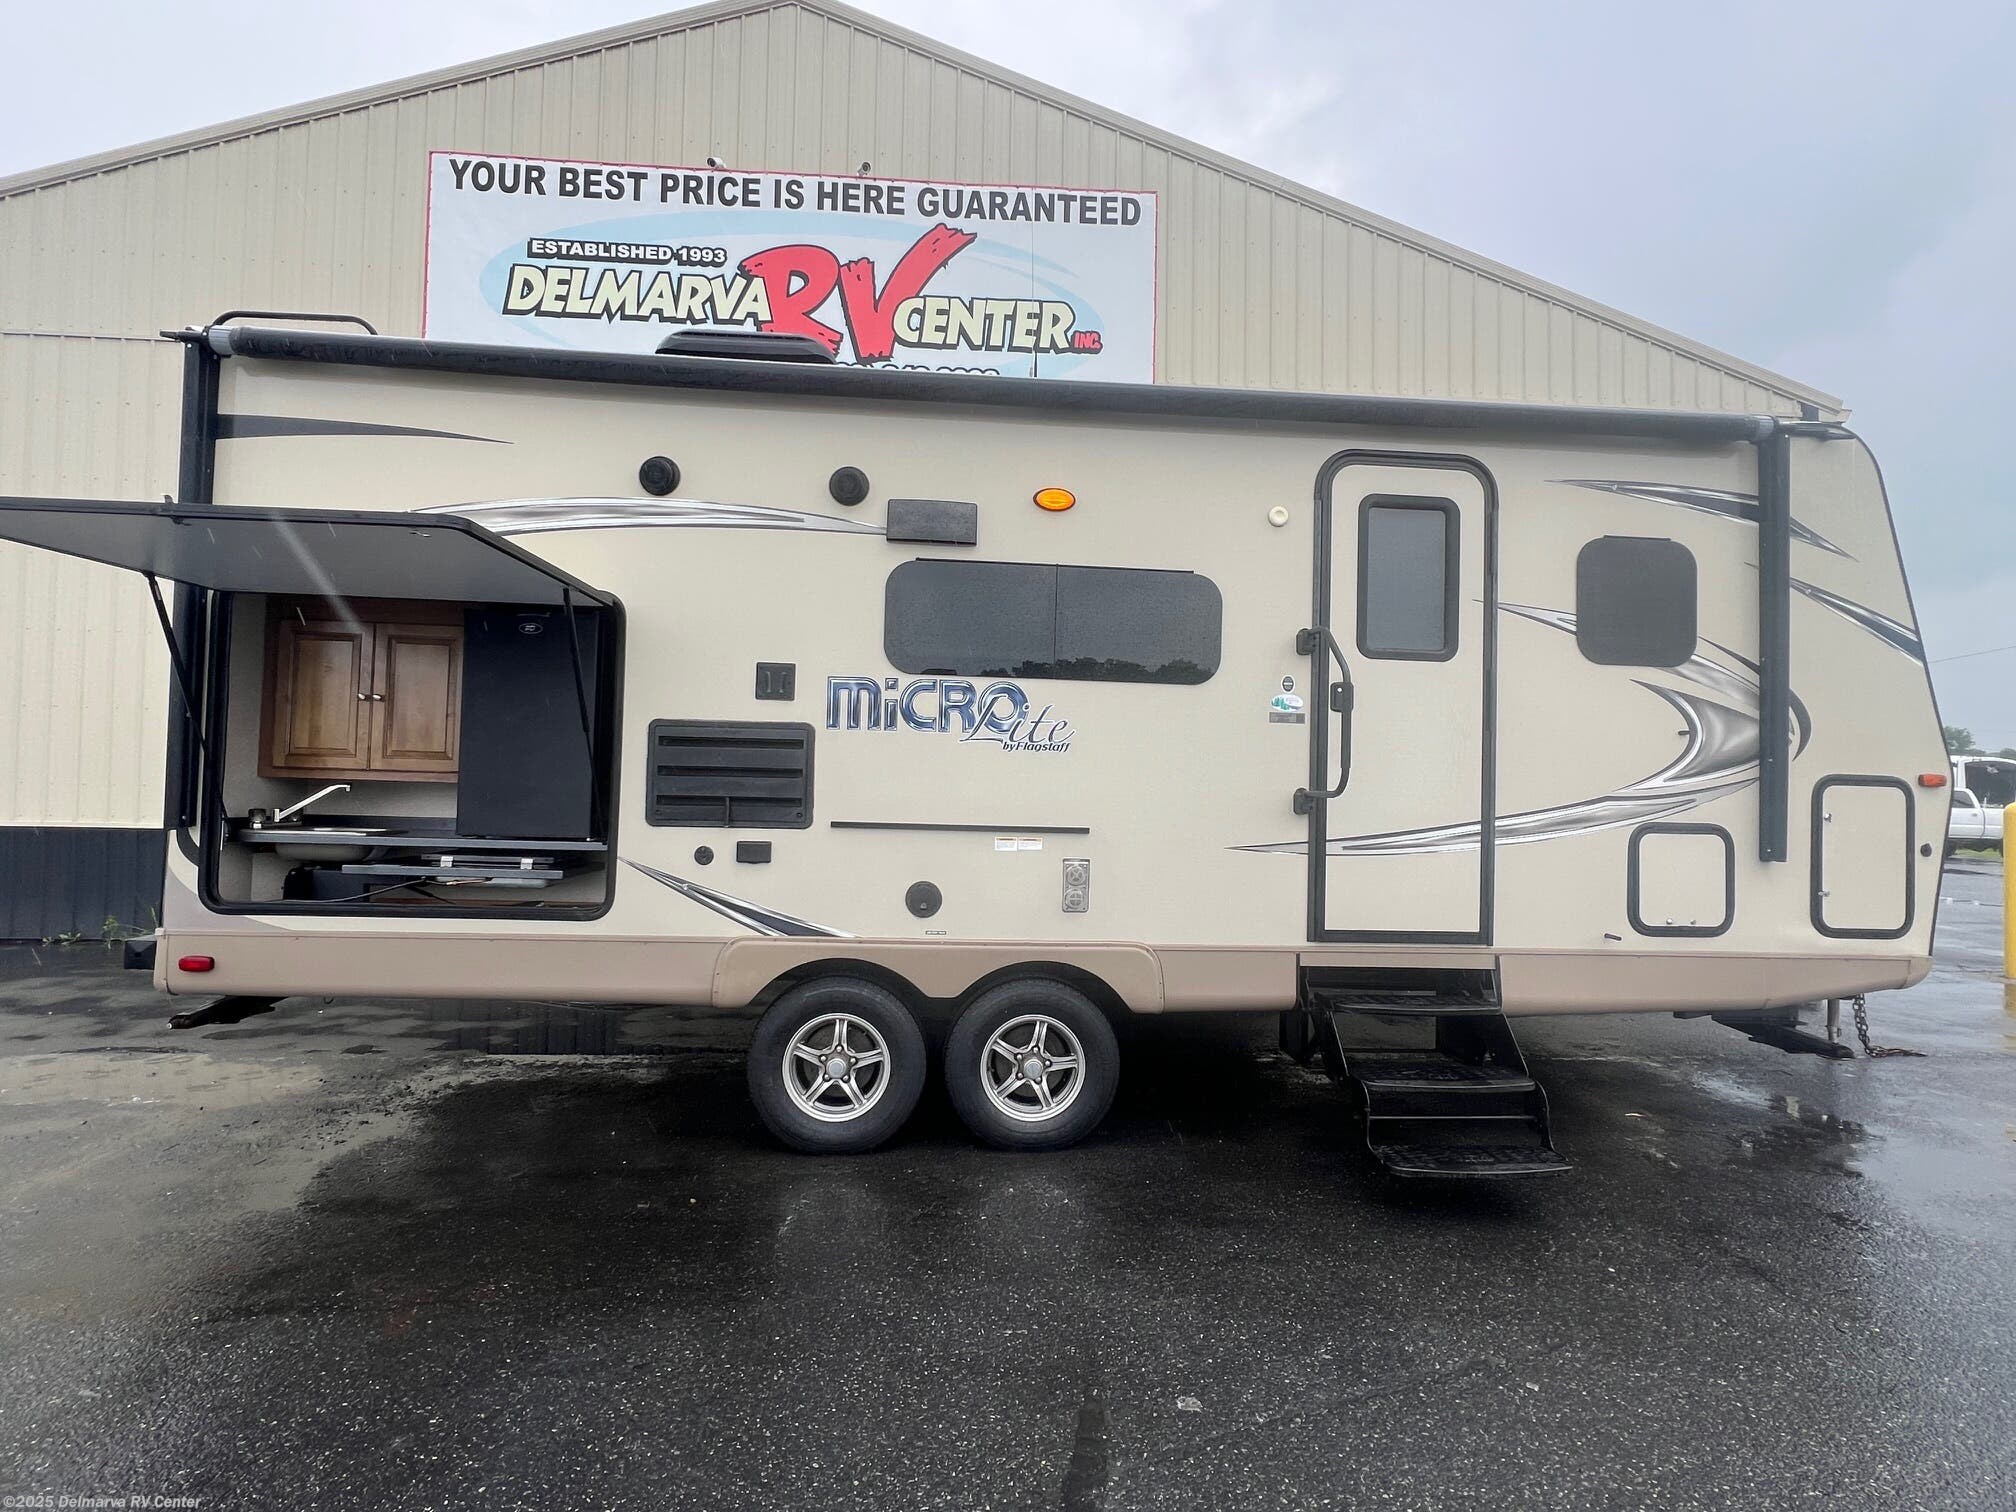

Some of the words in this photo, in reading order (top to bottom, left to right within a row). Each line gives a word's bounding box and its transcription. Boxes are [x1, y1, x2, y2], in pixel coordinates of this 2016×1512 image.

[449, 158, 546, 196] YOUR
[559, 166, 648, 202] BEST
[660, 173, 761, 207] PRICE
[774, 178, 804, 210] IS
[817, 181, 906, 215] HERE
[917, 187, 1142, 226] GUARANTEED
[530, 239, 673, 261] ESTABLISHED
[678, 247, 727, 264] 1993
[503, 265, 774, 326] DELMARVA
[737, 223, 978, 366] RV
[894, 296, 1076, 353] CENTER
[1072, 331, 1103, 351] INC.
[960, 695, 1075, 743] Lite
